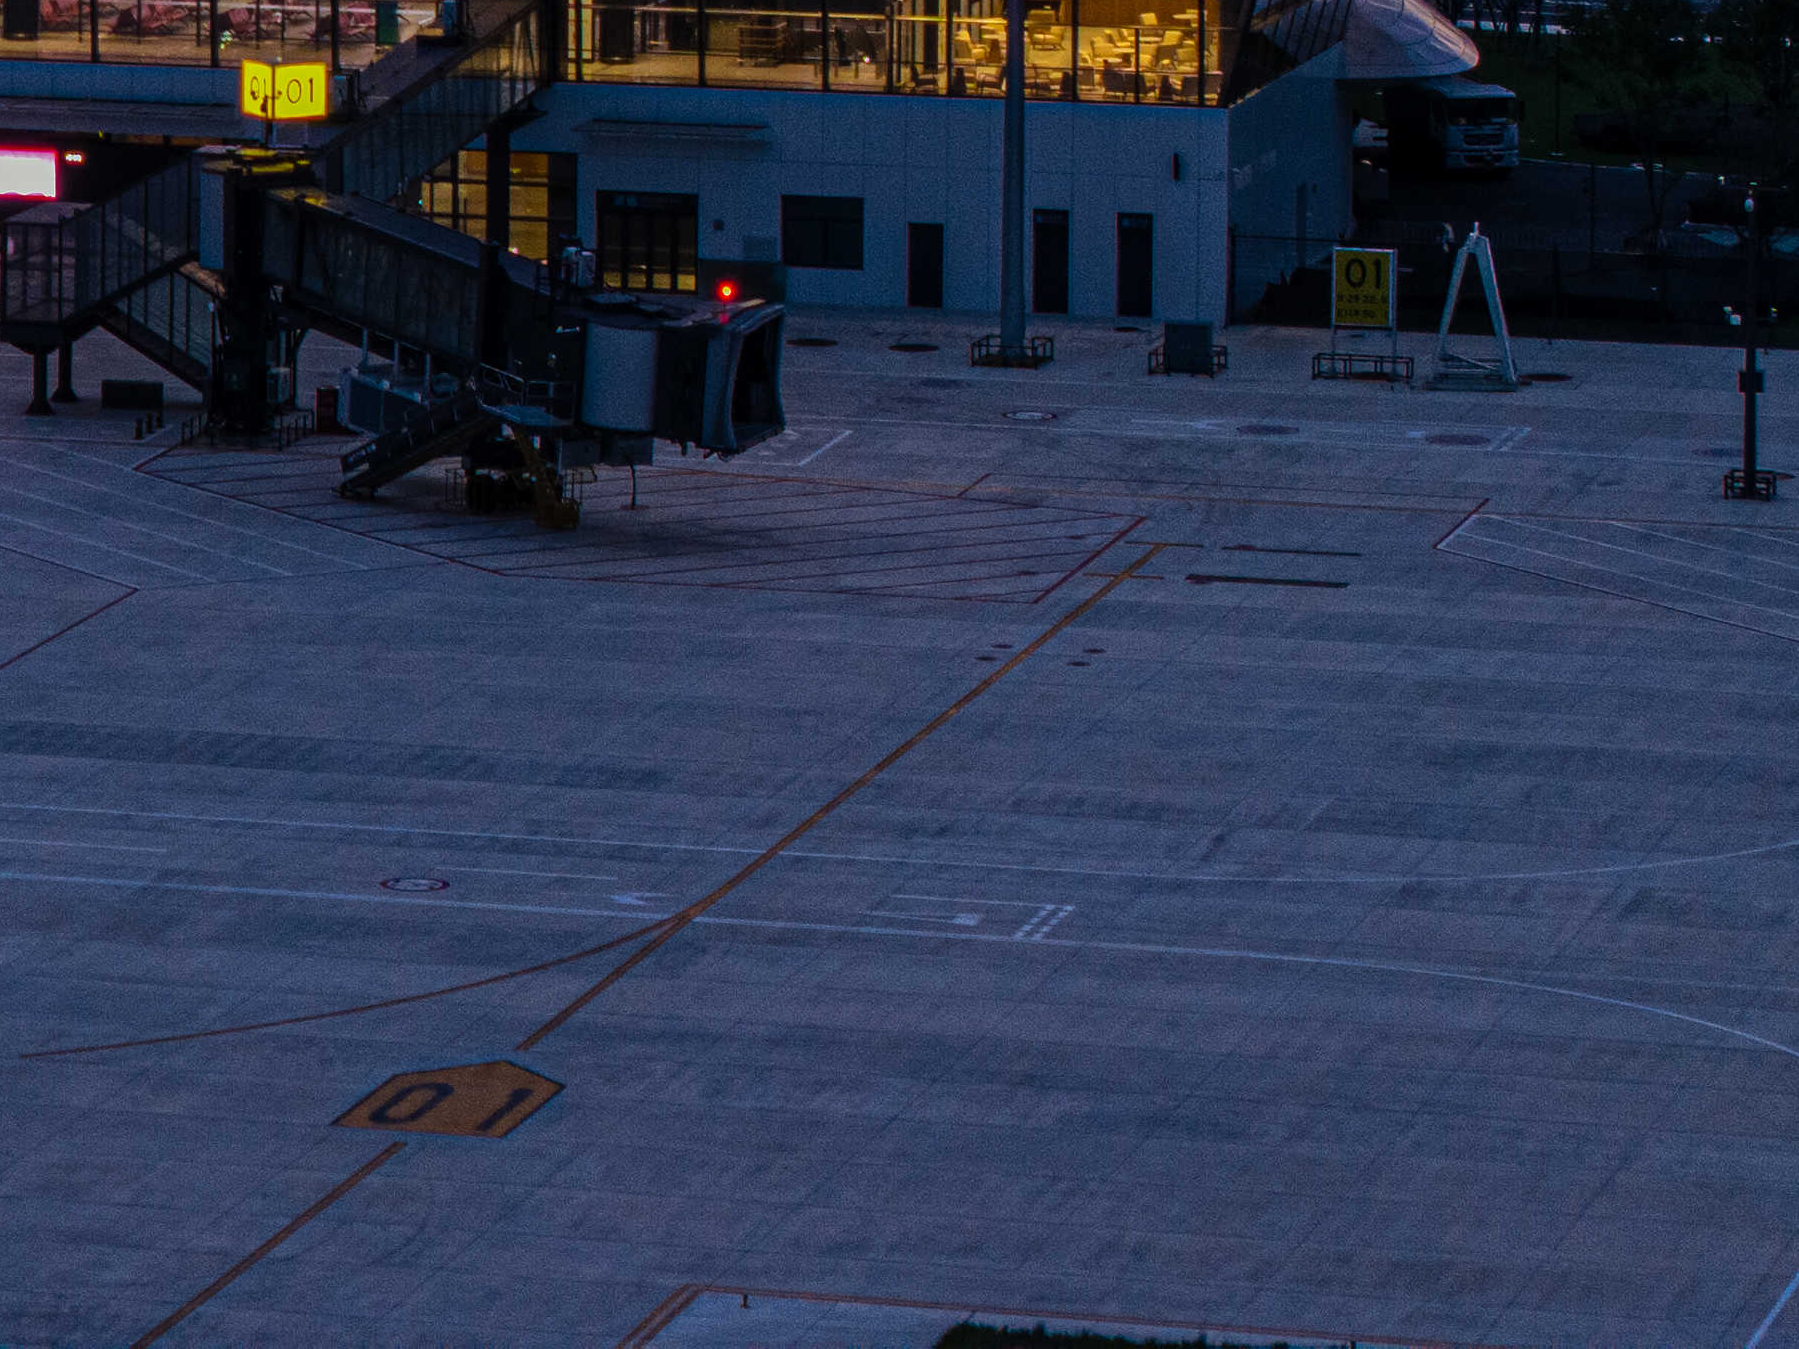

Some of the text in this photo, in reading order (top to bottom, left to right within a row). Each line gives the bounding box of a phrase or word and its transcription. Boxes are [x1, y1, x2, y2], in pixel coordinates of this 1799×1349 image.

[286, 77, 314, 104] 01
[1345, 258, 1381, 289] 01
[368, 1082, 538, 1133] 01
